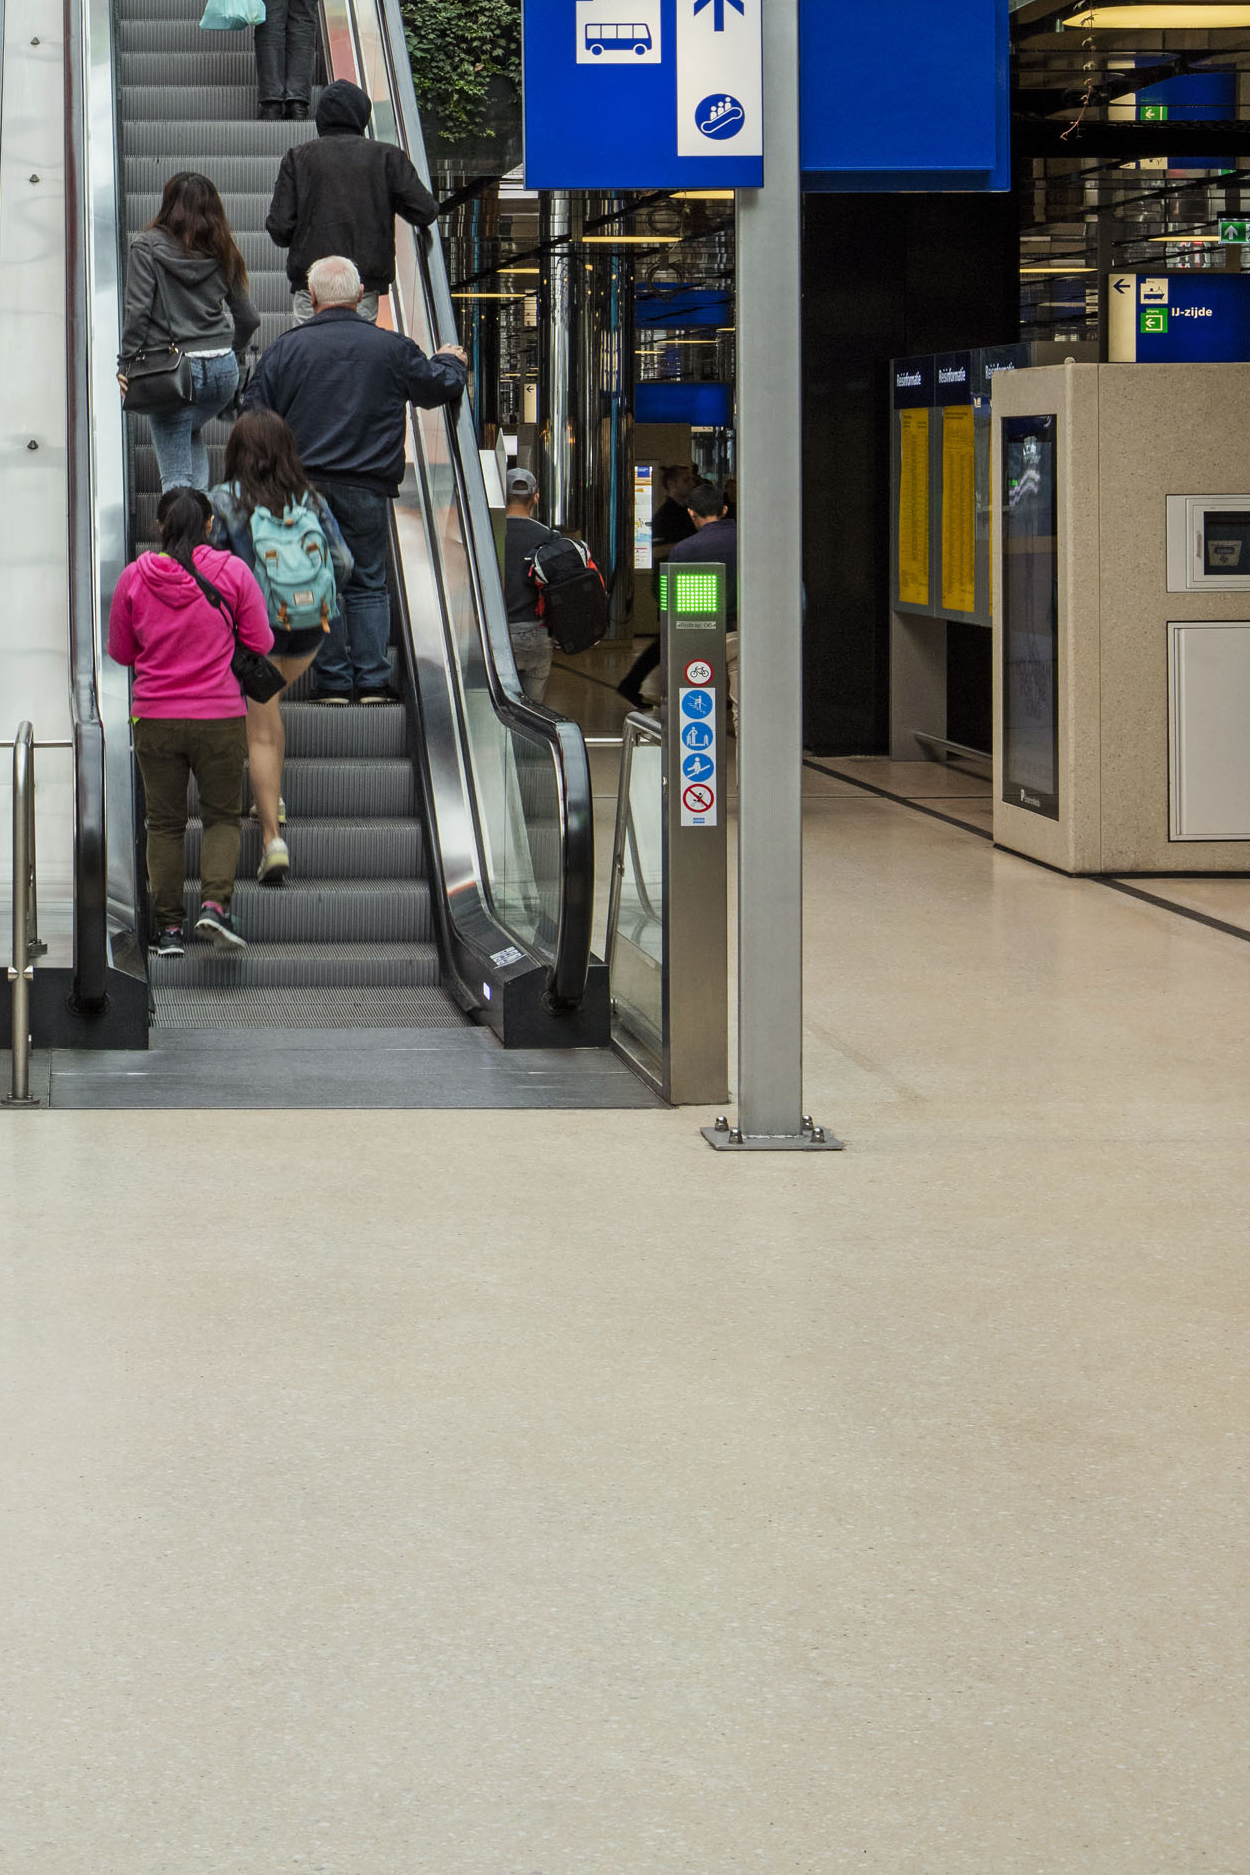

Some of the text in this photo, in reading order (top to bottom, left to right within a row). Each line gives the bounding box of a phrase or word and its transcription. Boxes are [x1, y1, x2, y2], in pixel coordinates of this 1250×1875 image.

[1171, 307, 1213, 319] IJ-zijde
[896, 371, 922, 387] Reisinformatie
[938, 367, 966, 384] Reisinformatie
